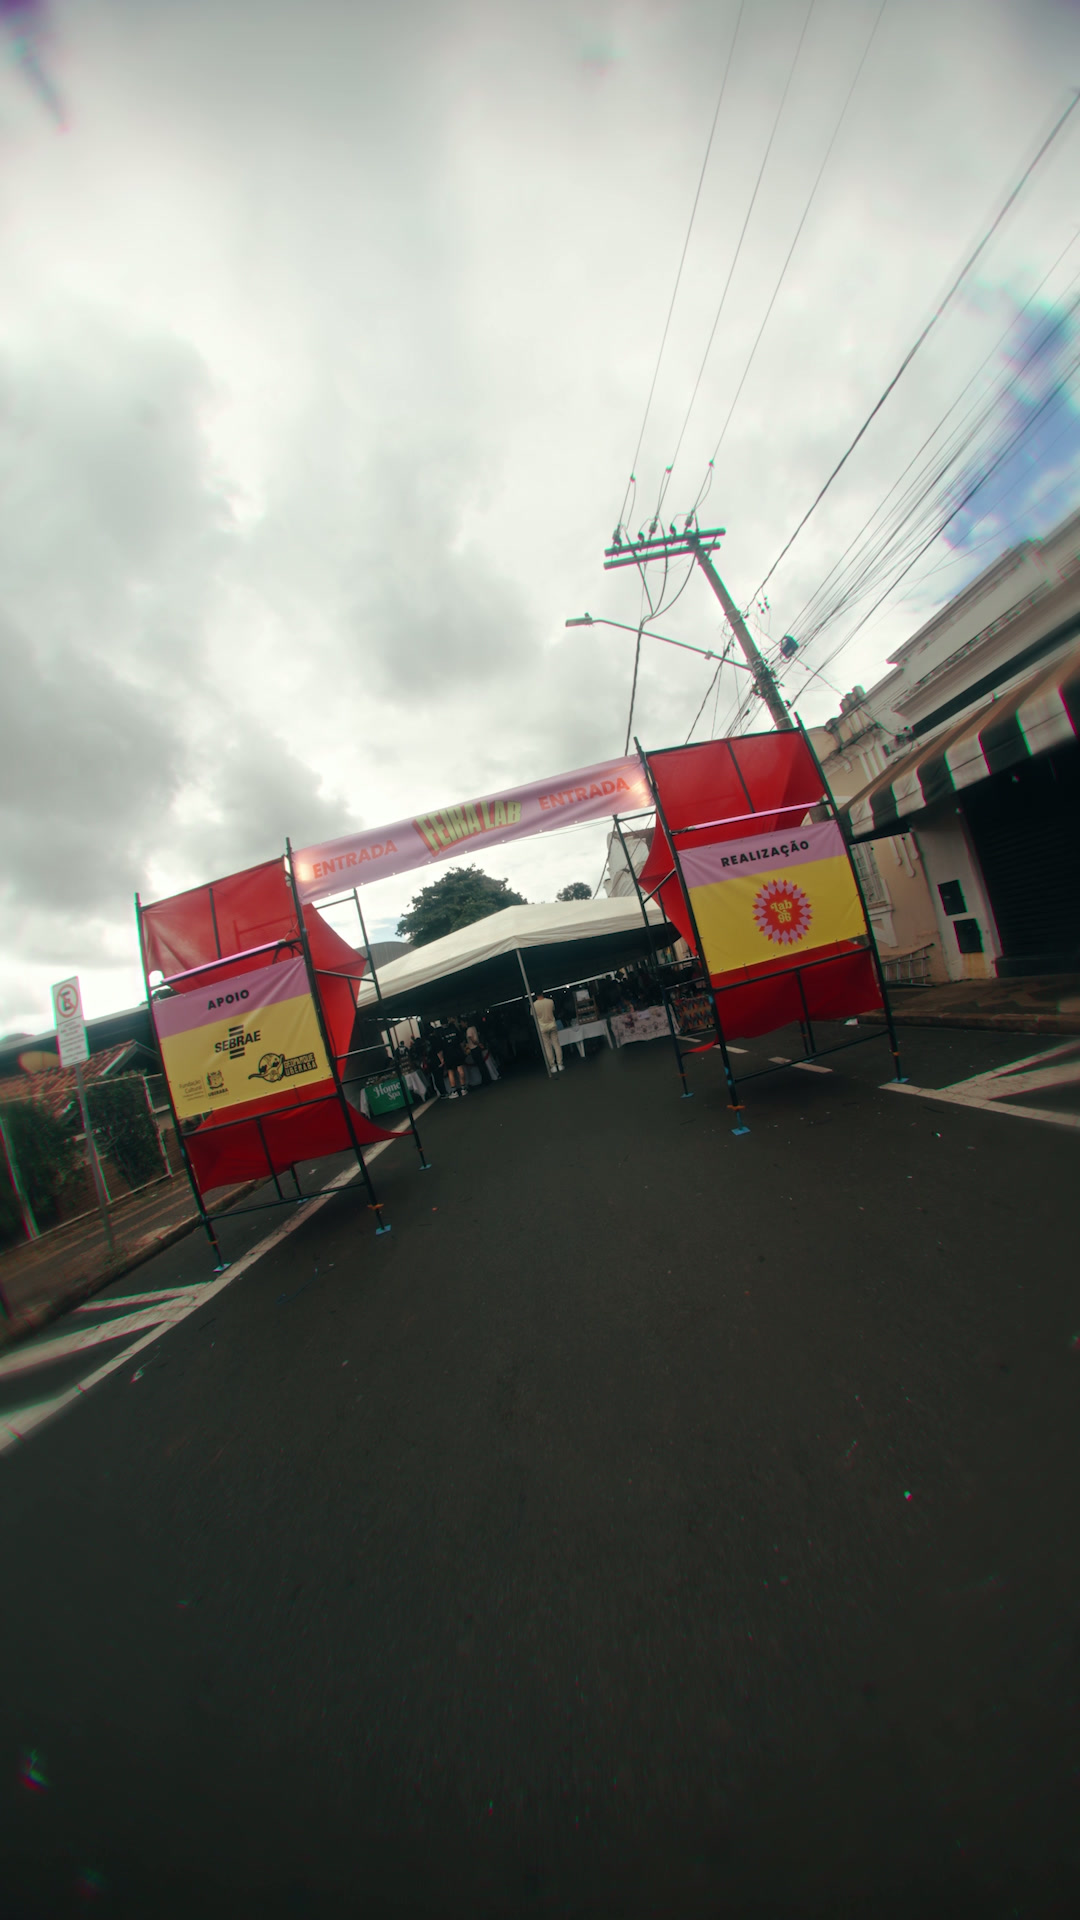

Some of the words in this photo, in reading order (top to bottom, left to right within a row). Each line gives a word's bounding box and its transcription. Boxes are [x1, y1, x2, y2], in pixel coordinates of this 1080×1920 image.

[312, 840, 398, 879] ENTRADA
[412, 803, 482, 856] FEIRA
[478, 800, 522, 832] LAB
[538, 777, 631, 811] ENTRADA
[720, 840, 810, 868] REALIZAÇÃO
[207, 989, 249, 1010] APOIO
[214, 1030, 261, 1053] SEBRAE
[373, 1082, 401, 1099] Home
